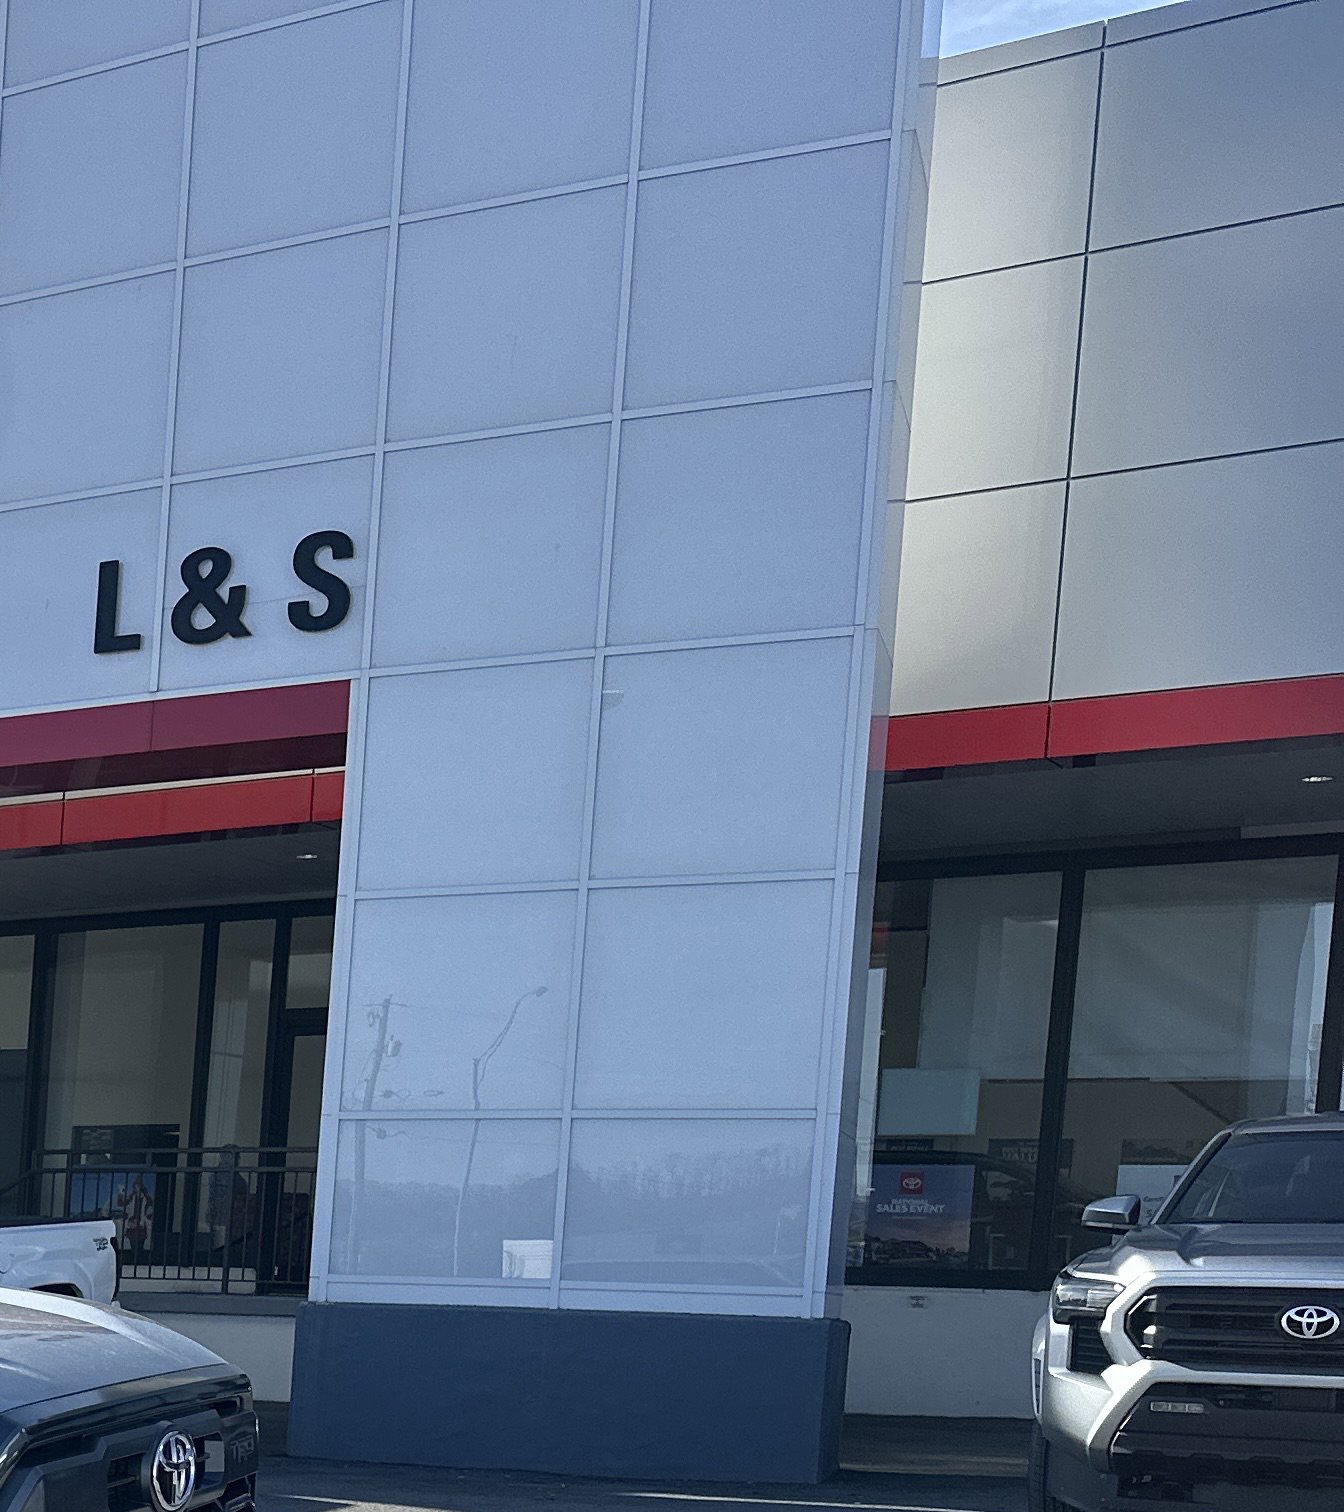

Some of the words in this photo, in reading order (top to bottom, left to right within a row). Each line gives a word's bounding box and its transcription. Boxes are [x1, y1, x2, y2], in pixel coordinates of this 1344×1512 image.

[94, 560, 141, 654] L
[171, 546, 253, 645] &
[288, 530, 354, 632] S
[876, 1204, 908, 1213] SALES
[909, 1205, 945, 1213] EVENT
[230, 1435, 255, 1463] TRD
